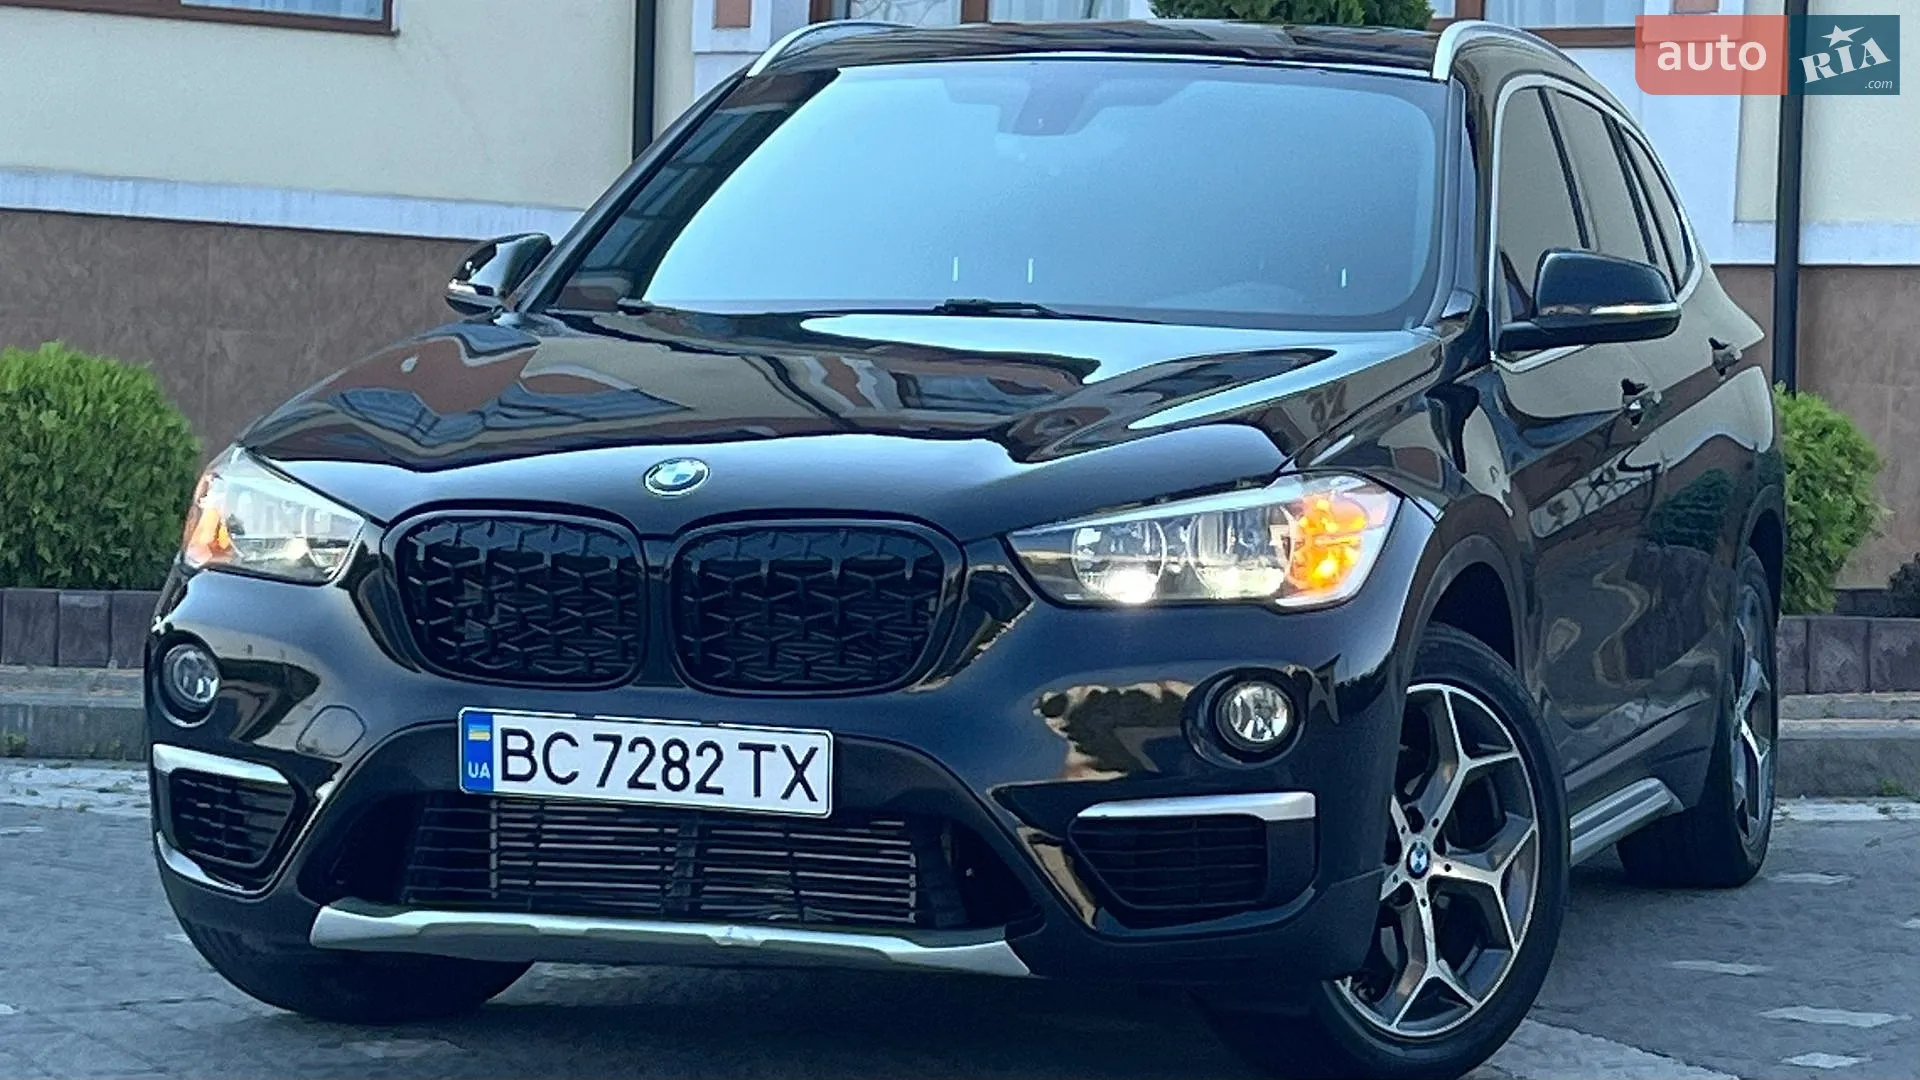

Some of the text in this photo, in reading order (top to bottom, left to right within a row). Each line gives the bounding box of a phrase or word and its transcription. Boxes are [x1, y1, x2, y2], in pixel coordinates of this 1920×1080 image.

[467, 761, 491, 779] UA
[500, 727, 819, 802] BC 7282 TX
